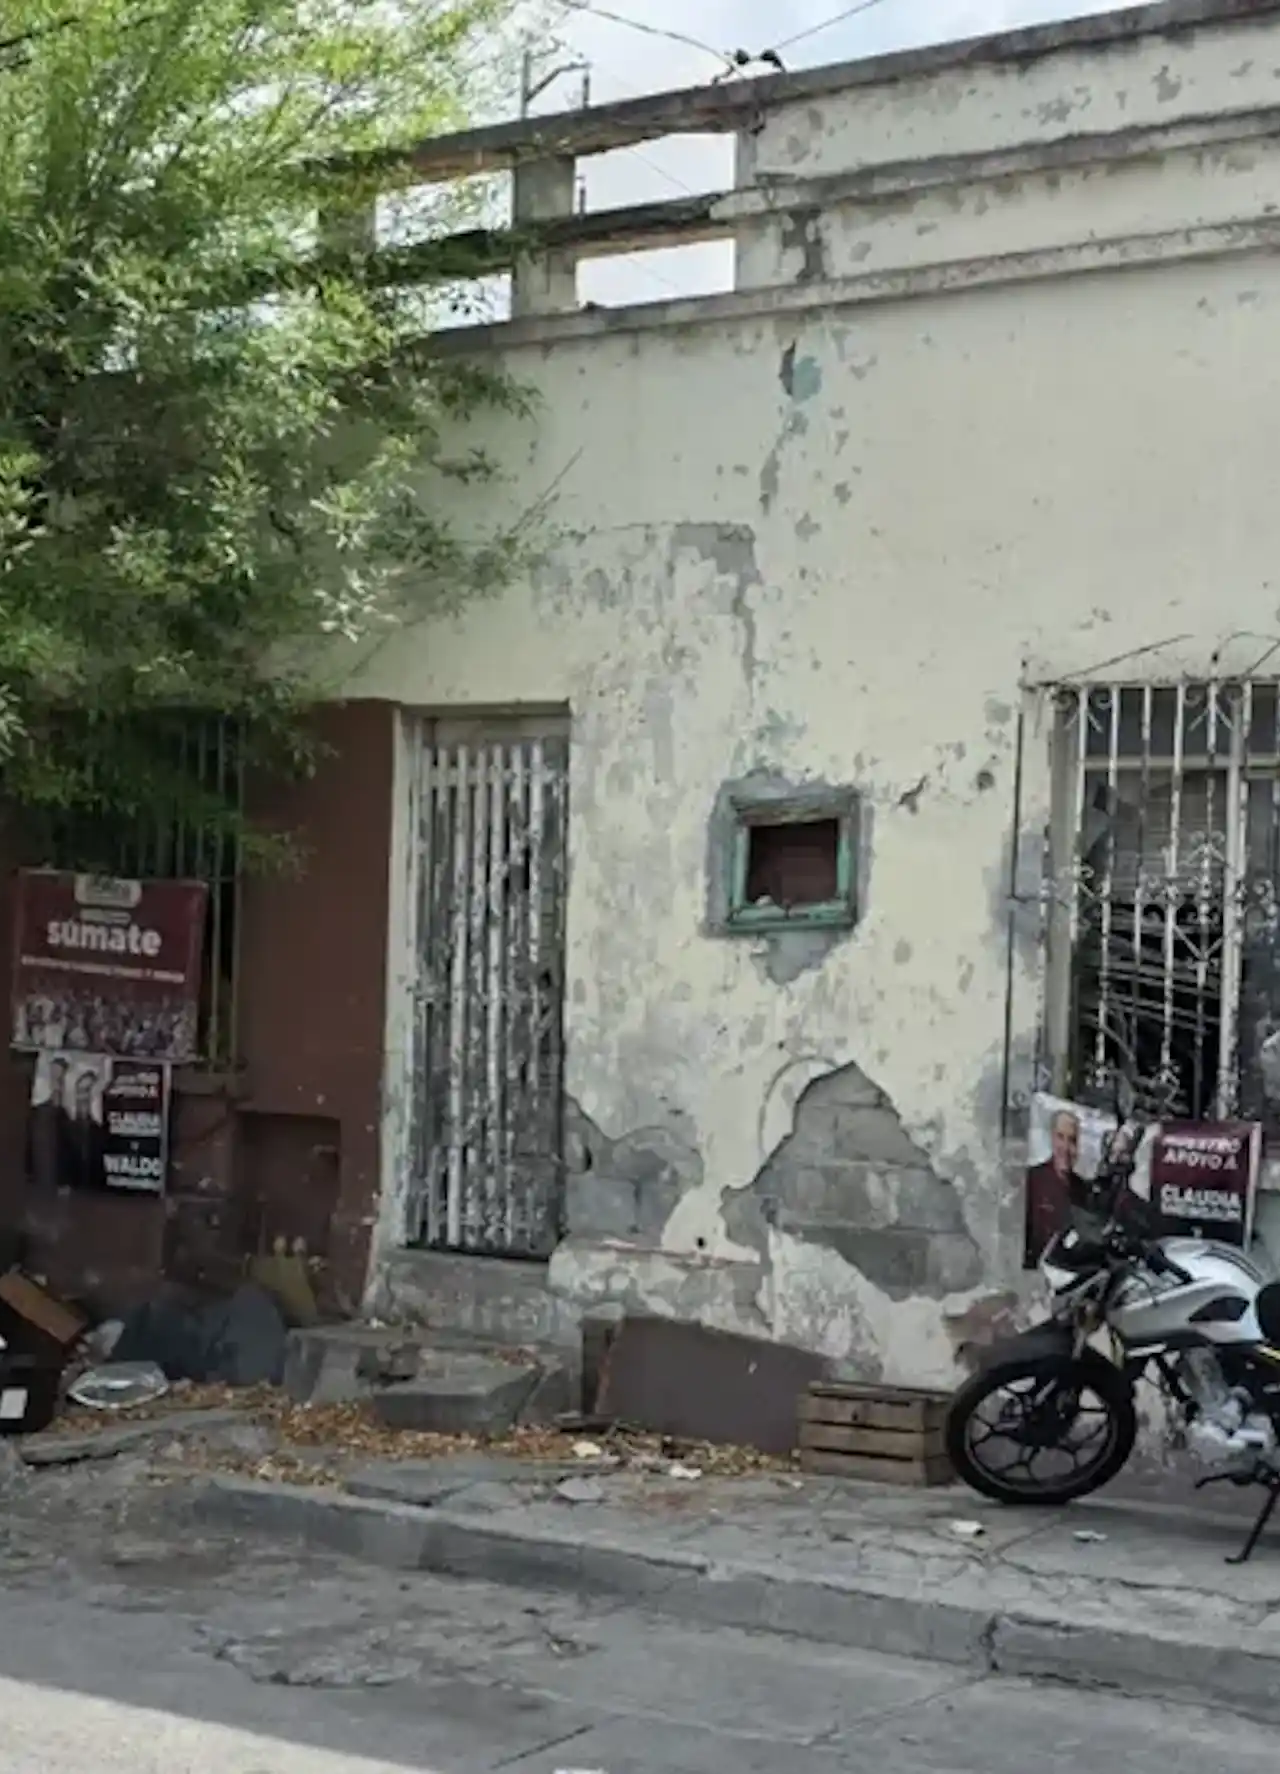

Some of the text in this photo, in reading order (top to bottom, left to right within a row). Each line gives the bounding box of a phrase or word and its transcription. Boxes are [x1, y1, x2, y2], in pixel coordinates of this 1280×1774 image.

[47, 917, 162, 956] súmate
[103, 1153, 162, 1176] WALDO
[1162, 1147, 1223, 1171] APOYO
